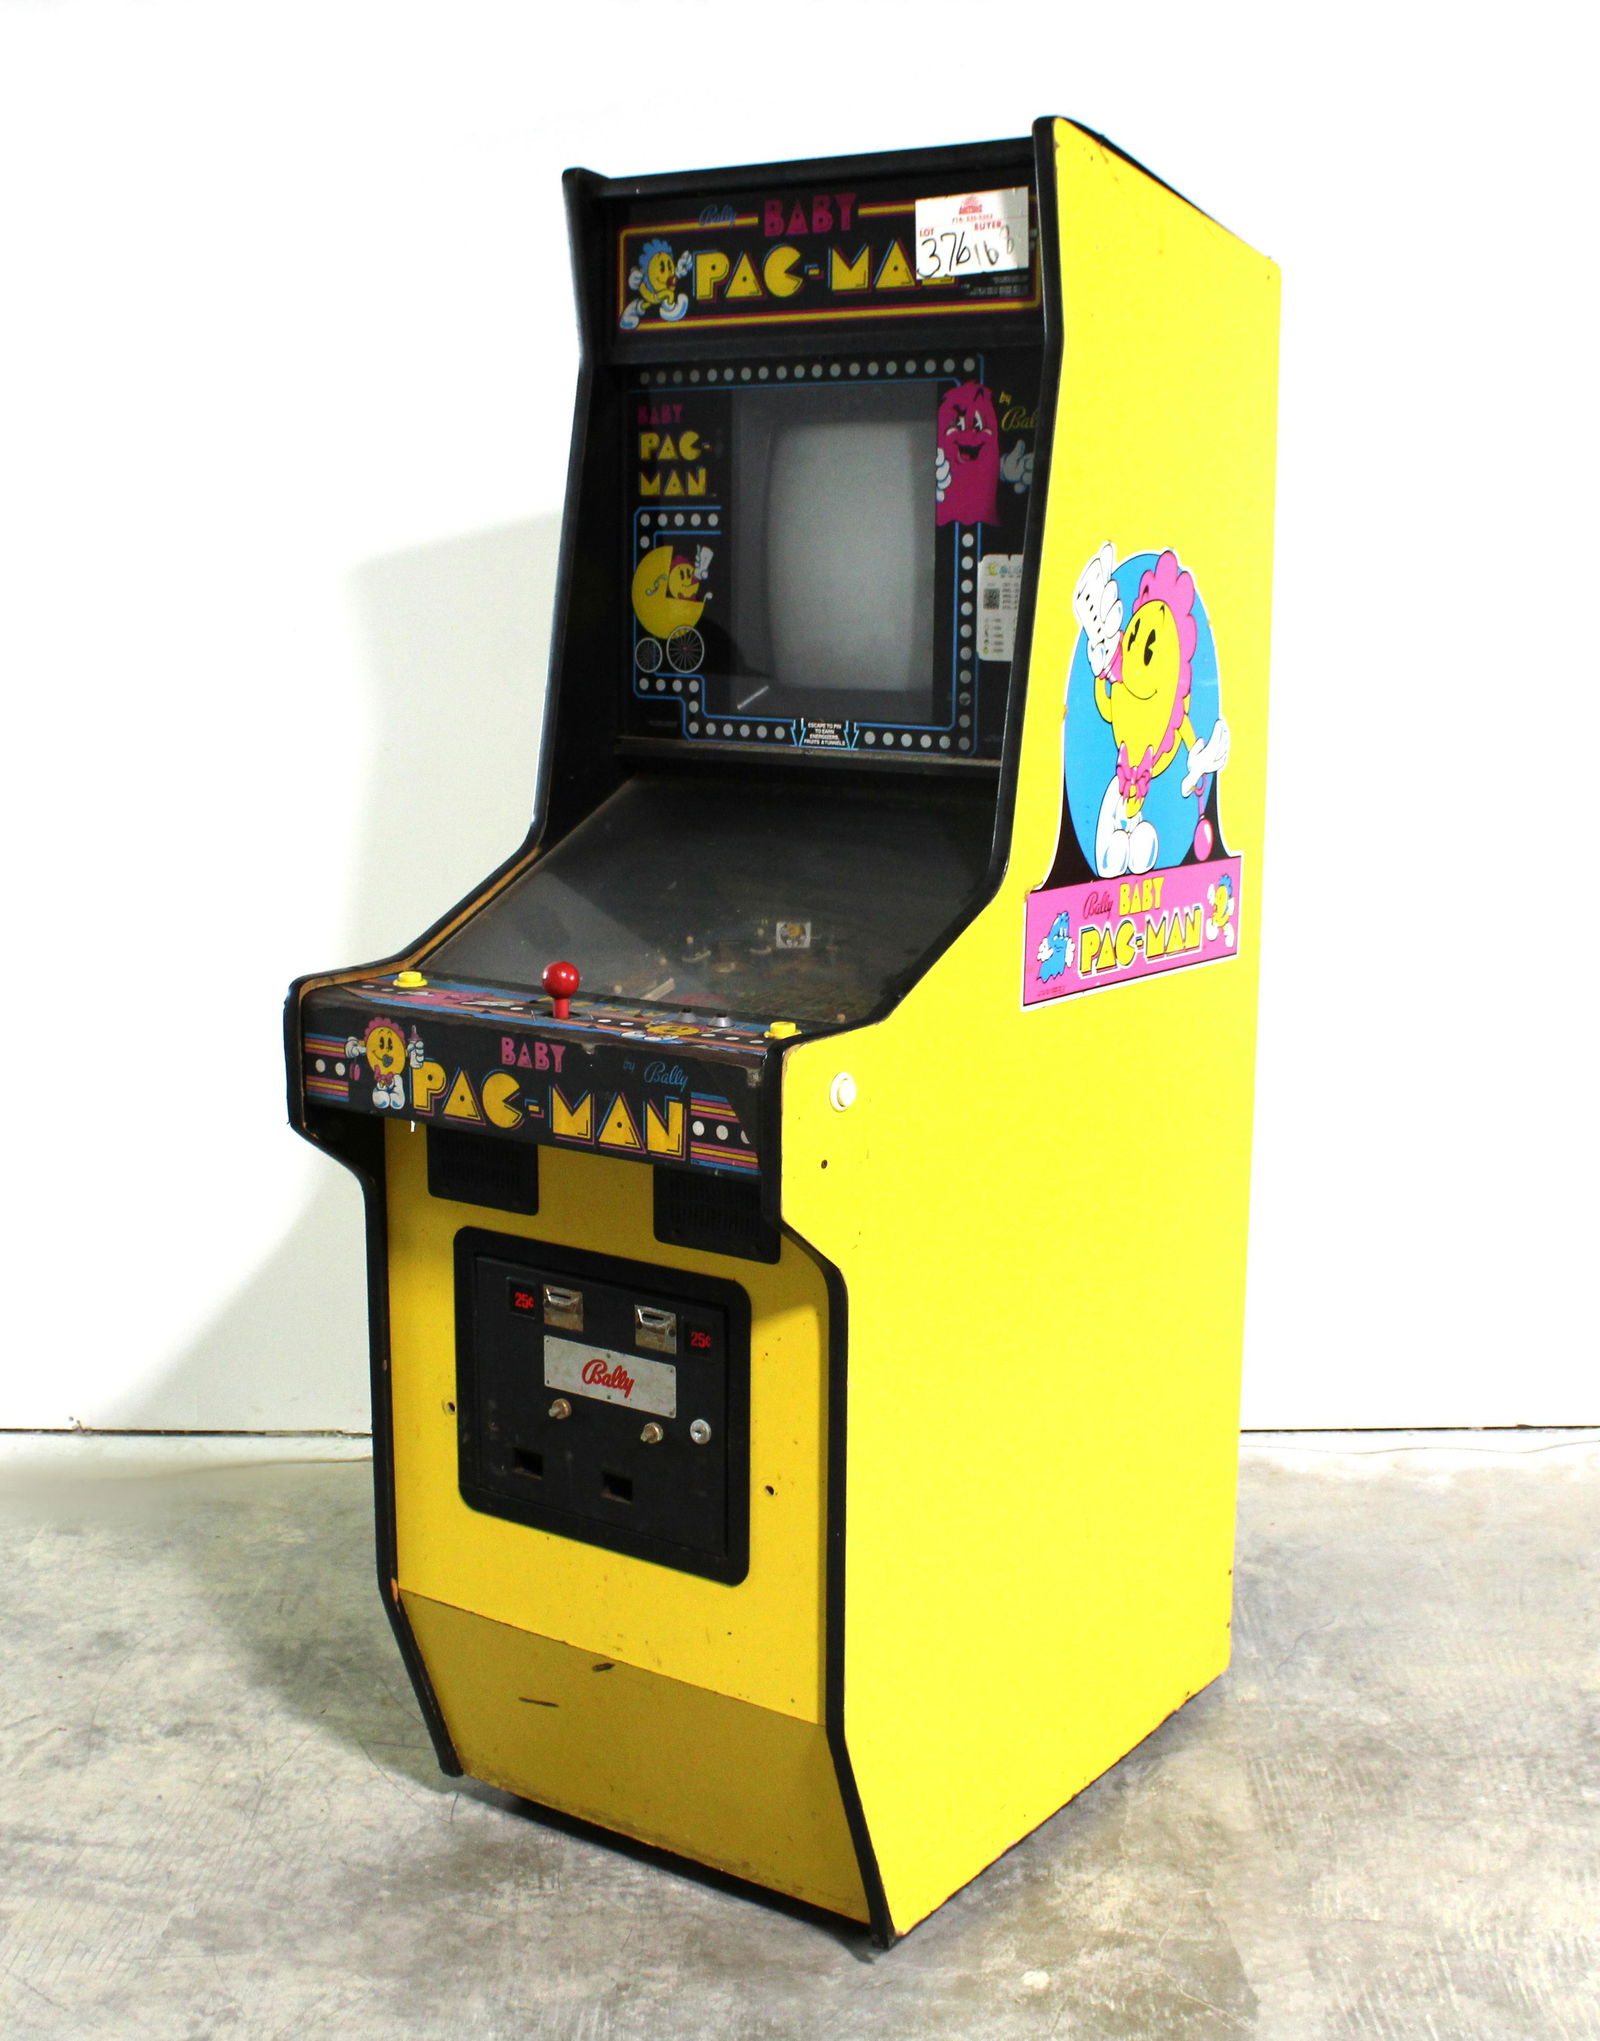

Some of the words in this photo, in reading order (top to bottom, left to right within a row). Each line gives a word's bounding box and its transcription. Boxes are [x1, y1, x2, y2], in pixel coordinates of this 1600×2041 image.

[698, 204, 737, 229] Bally
[764, 193, 857, 237] BABY
[919, 228, 935, 238] LOT
[692, 238, 958, 304] PAC-MA
[637, 404, 683, 425] BABY
[999, 391, 1012, 405] by
[639, 429, 712, 462] PAC-
[639, 466, 708, 497] MAN
[1083, 892, 1113, 919] Bally
[1119, 877, 1164, 915] BABY
[1078, 904, 1203, 977] PAC-MAN
[501, 1037, 567, 1073] BABY
[623, 1060, 636, 1073] by
[643, 1060, 689, 1093] Bally
[409, 1056, 687, 1161] PAC-MAN
[514, 1291, 535, 1309] 25¢
[690, 1331, 712, 1348] 25¢
[581, 1358, 635, 1399] Bally
